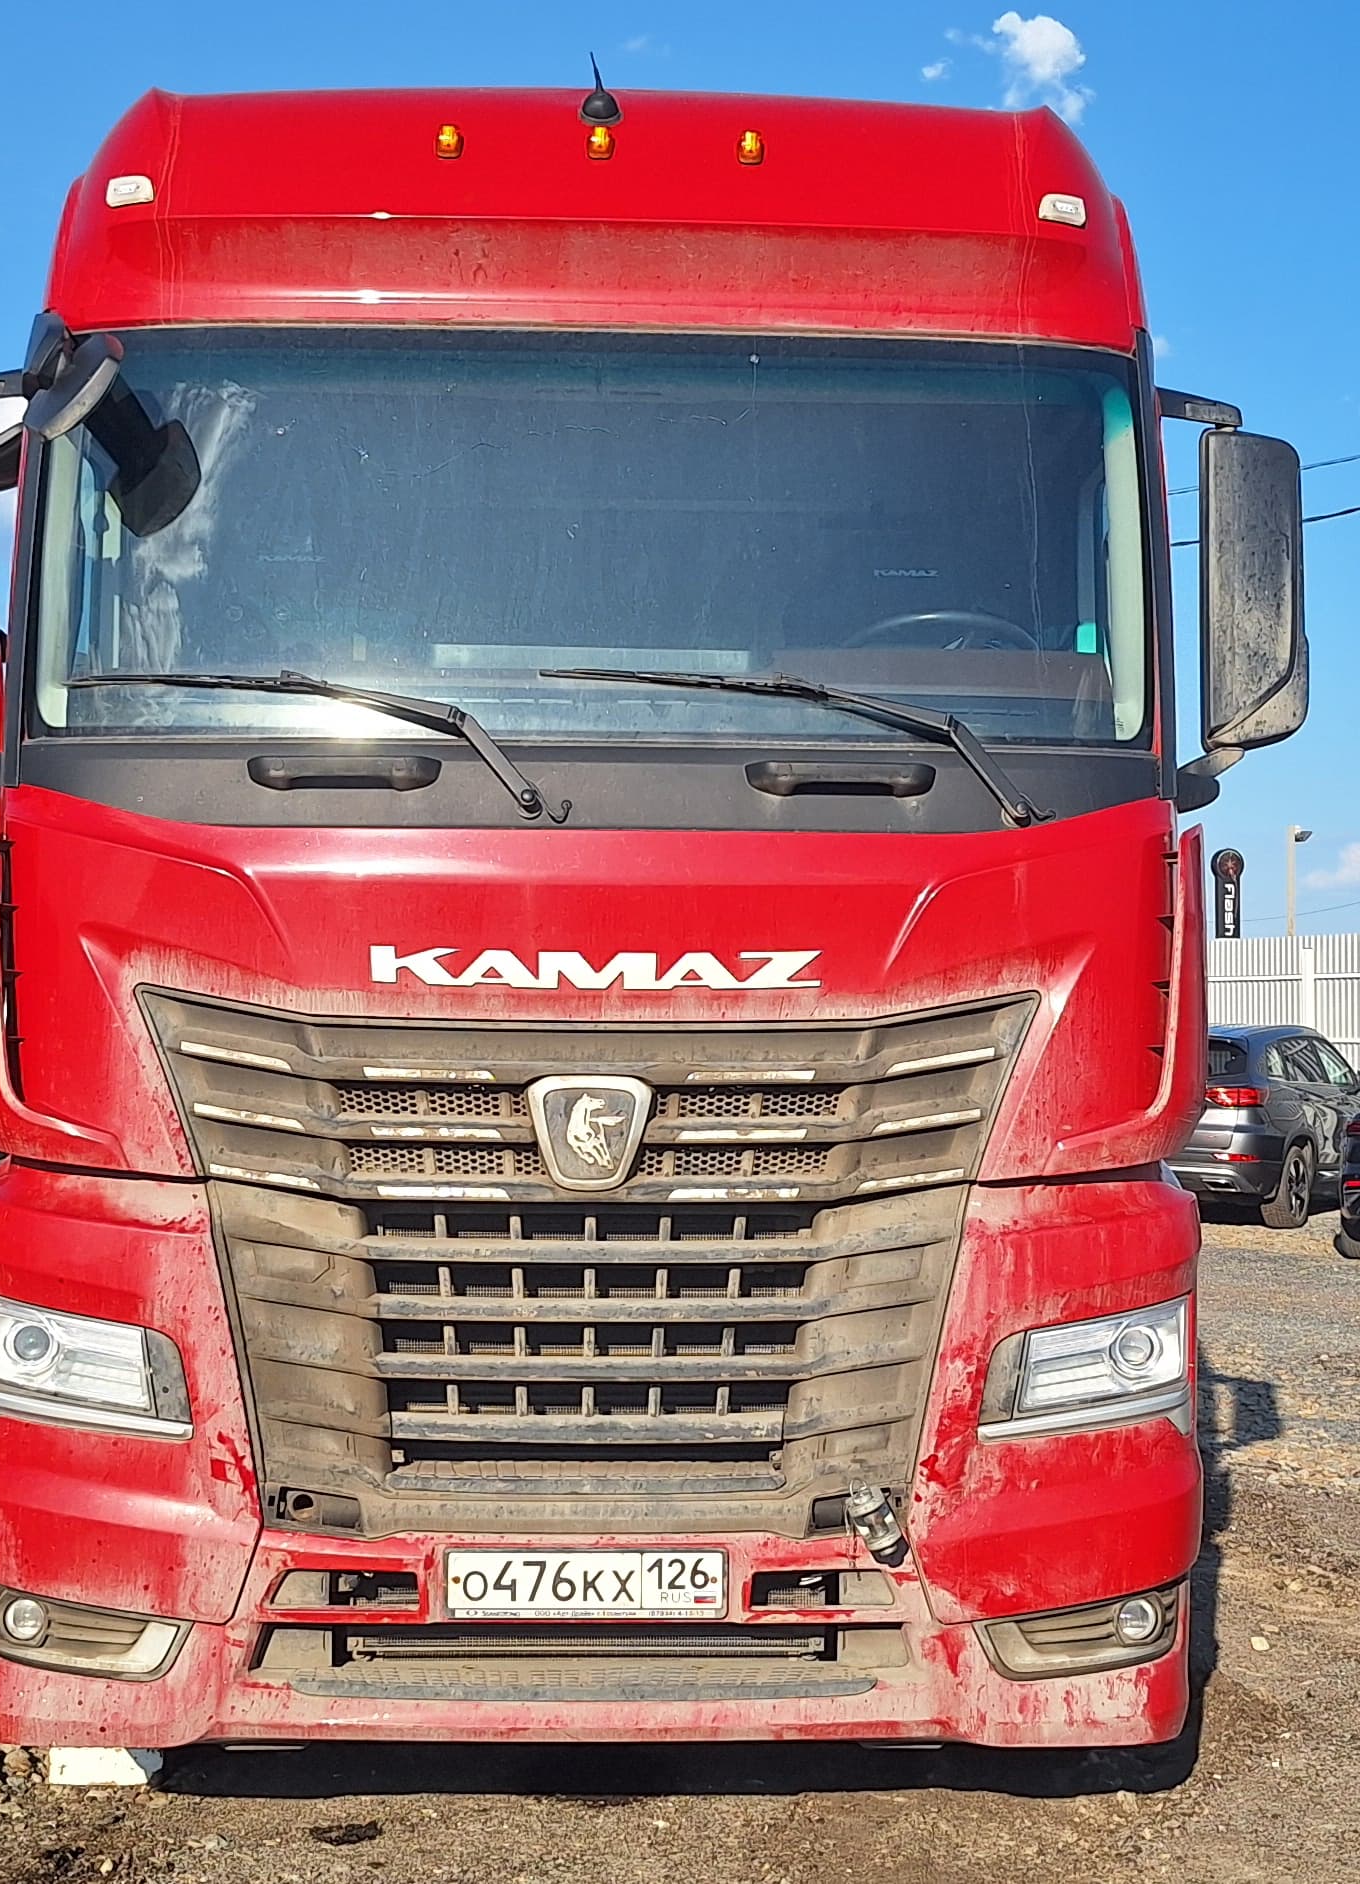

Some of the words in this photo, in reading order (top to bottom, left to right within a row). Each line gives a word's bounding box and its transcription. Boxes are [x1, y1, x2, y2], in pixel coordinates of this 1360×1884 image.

[873, 569, 939, 577] KAMAZ
[1224, 883, 1236, 936] Flash
[369, 944, 823, 991] KAMAZ
[647, 1557, 711, 1591] 126
[659, 1591, 692, 1604] RUS
